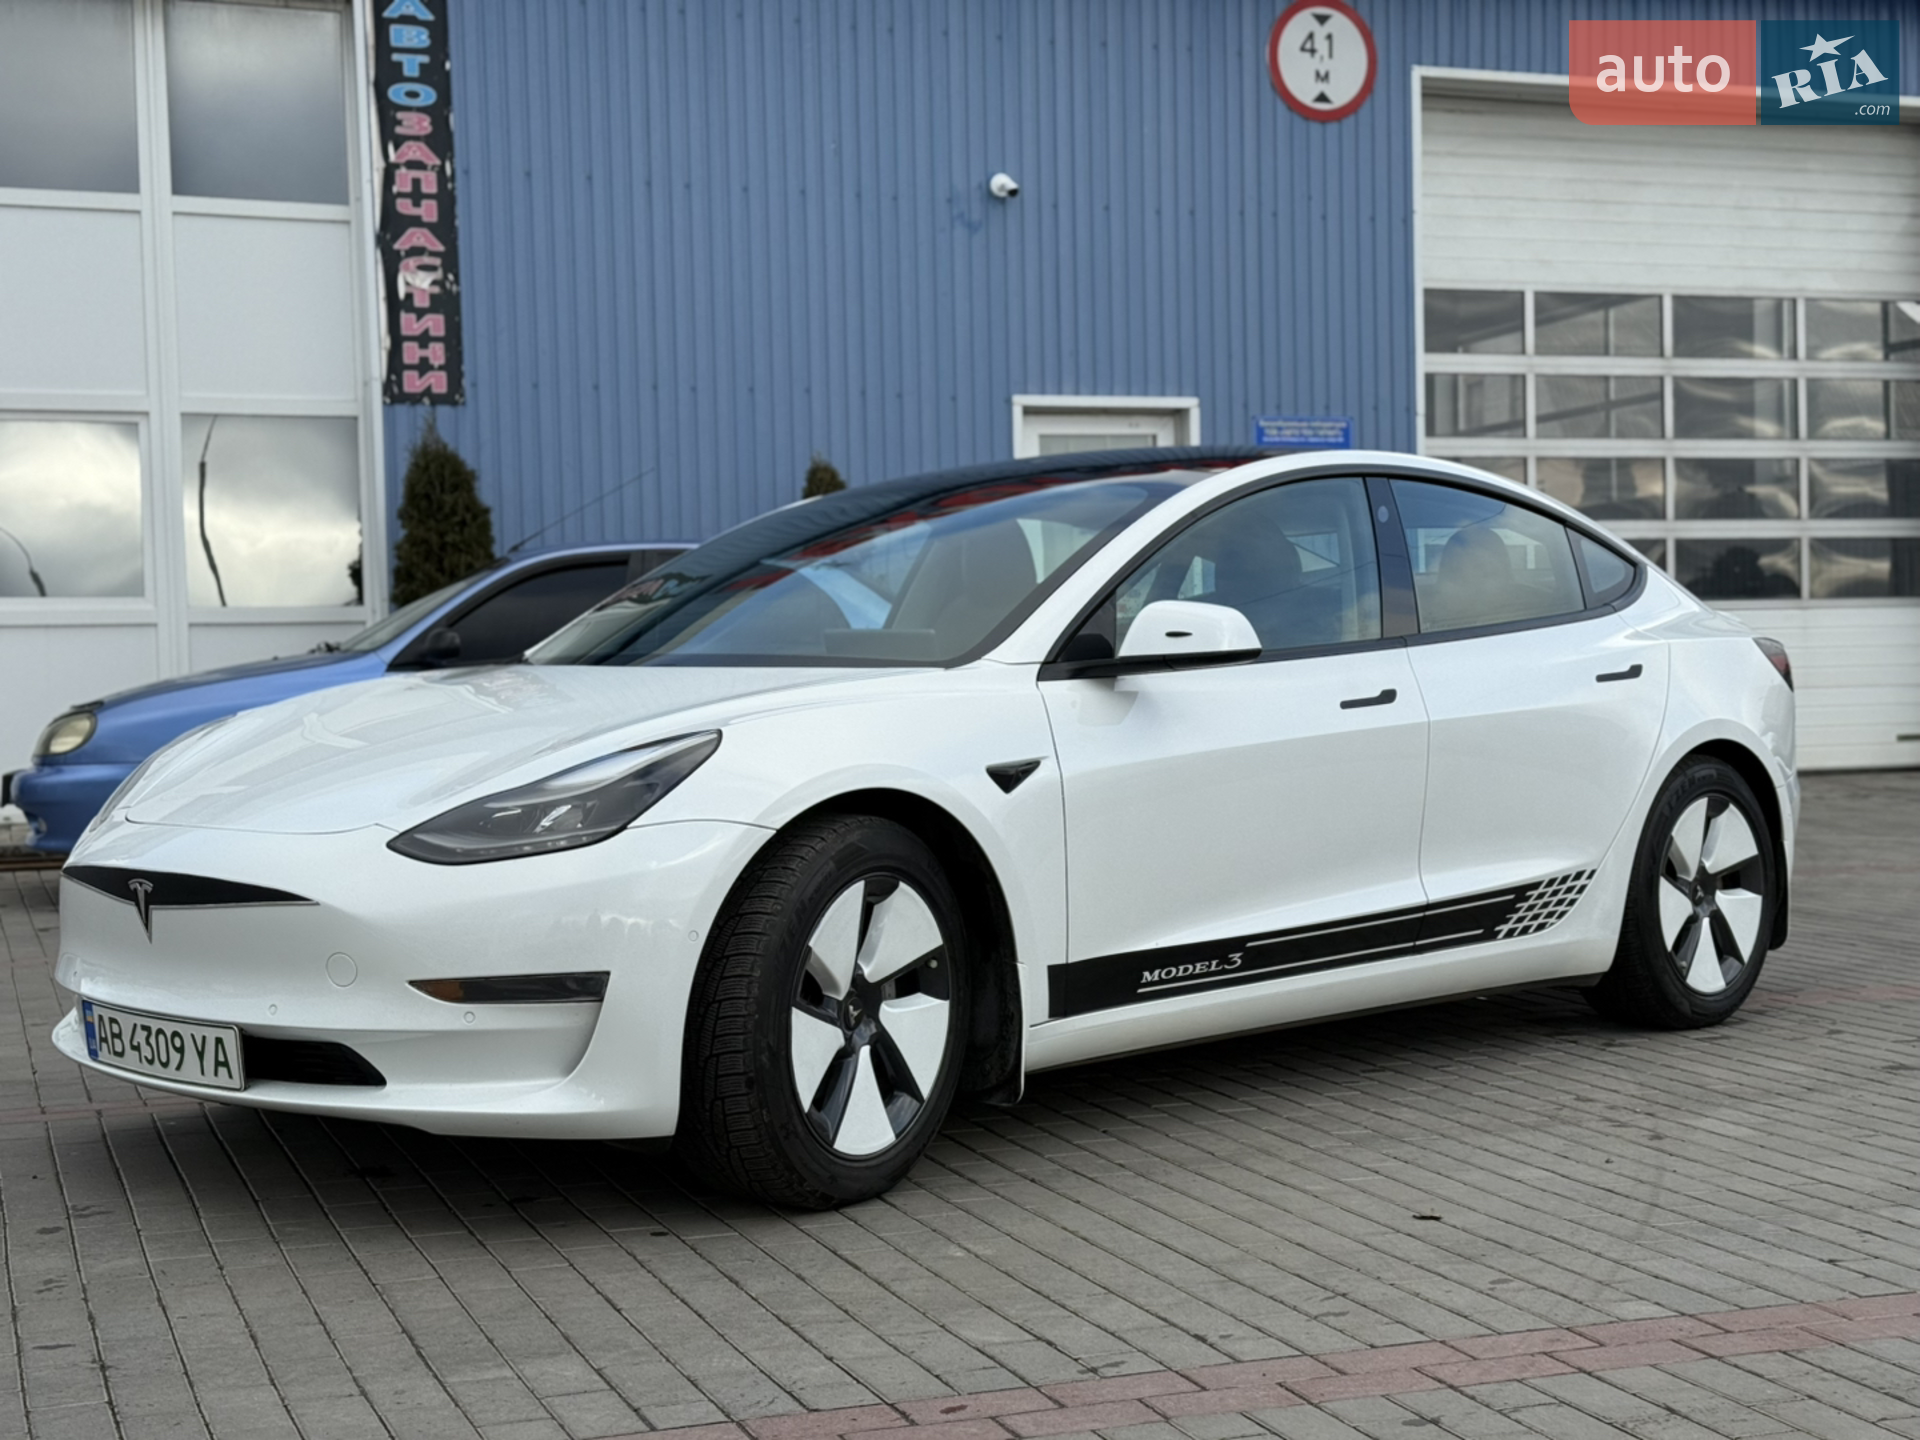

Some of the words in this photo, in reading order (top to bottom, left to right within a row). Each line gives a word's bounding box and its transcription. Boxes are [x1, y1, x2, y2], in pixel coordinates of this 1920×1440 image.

[1299, 30, 1334, 63] 4,1
[98, 1013, 125, 1058] AB
[130, 1022, 185, 1071] 4309
[190, 1032, 233, 1080] YA
